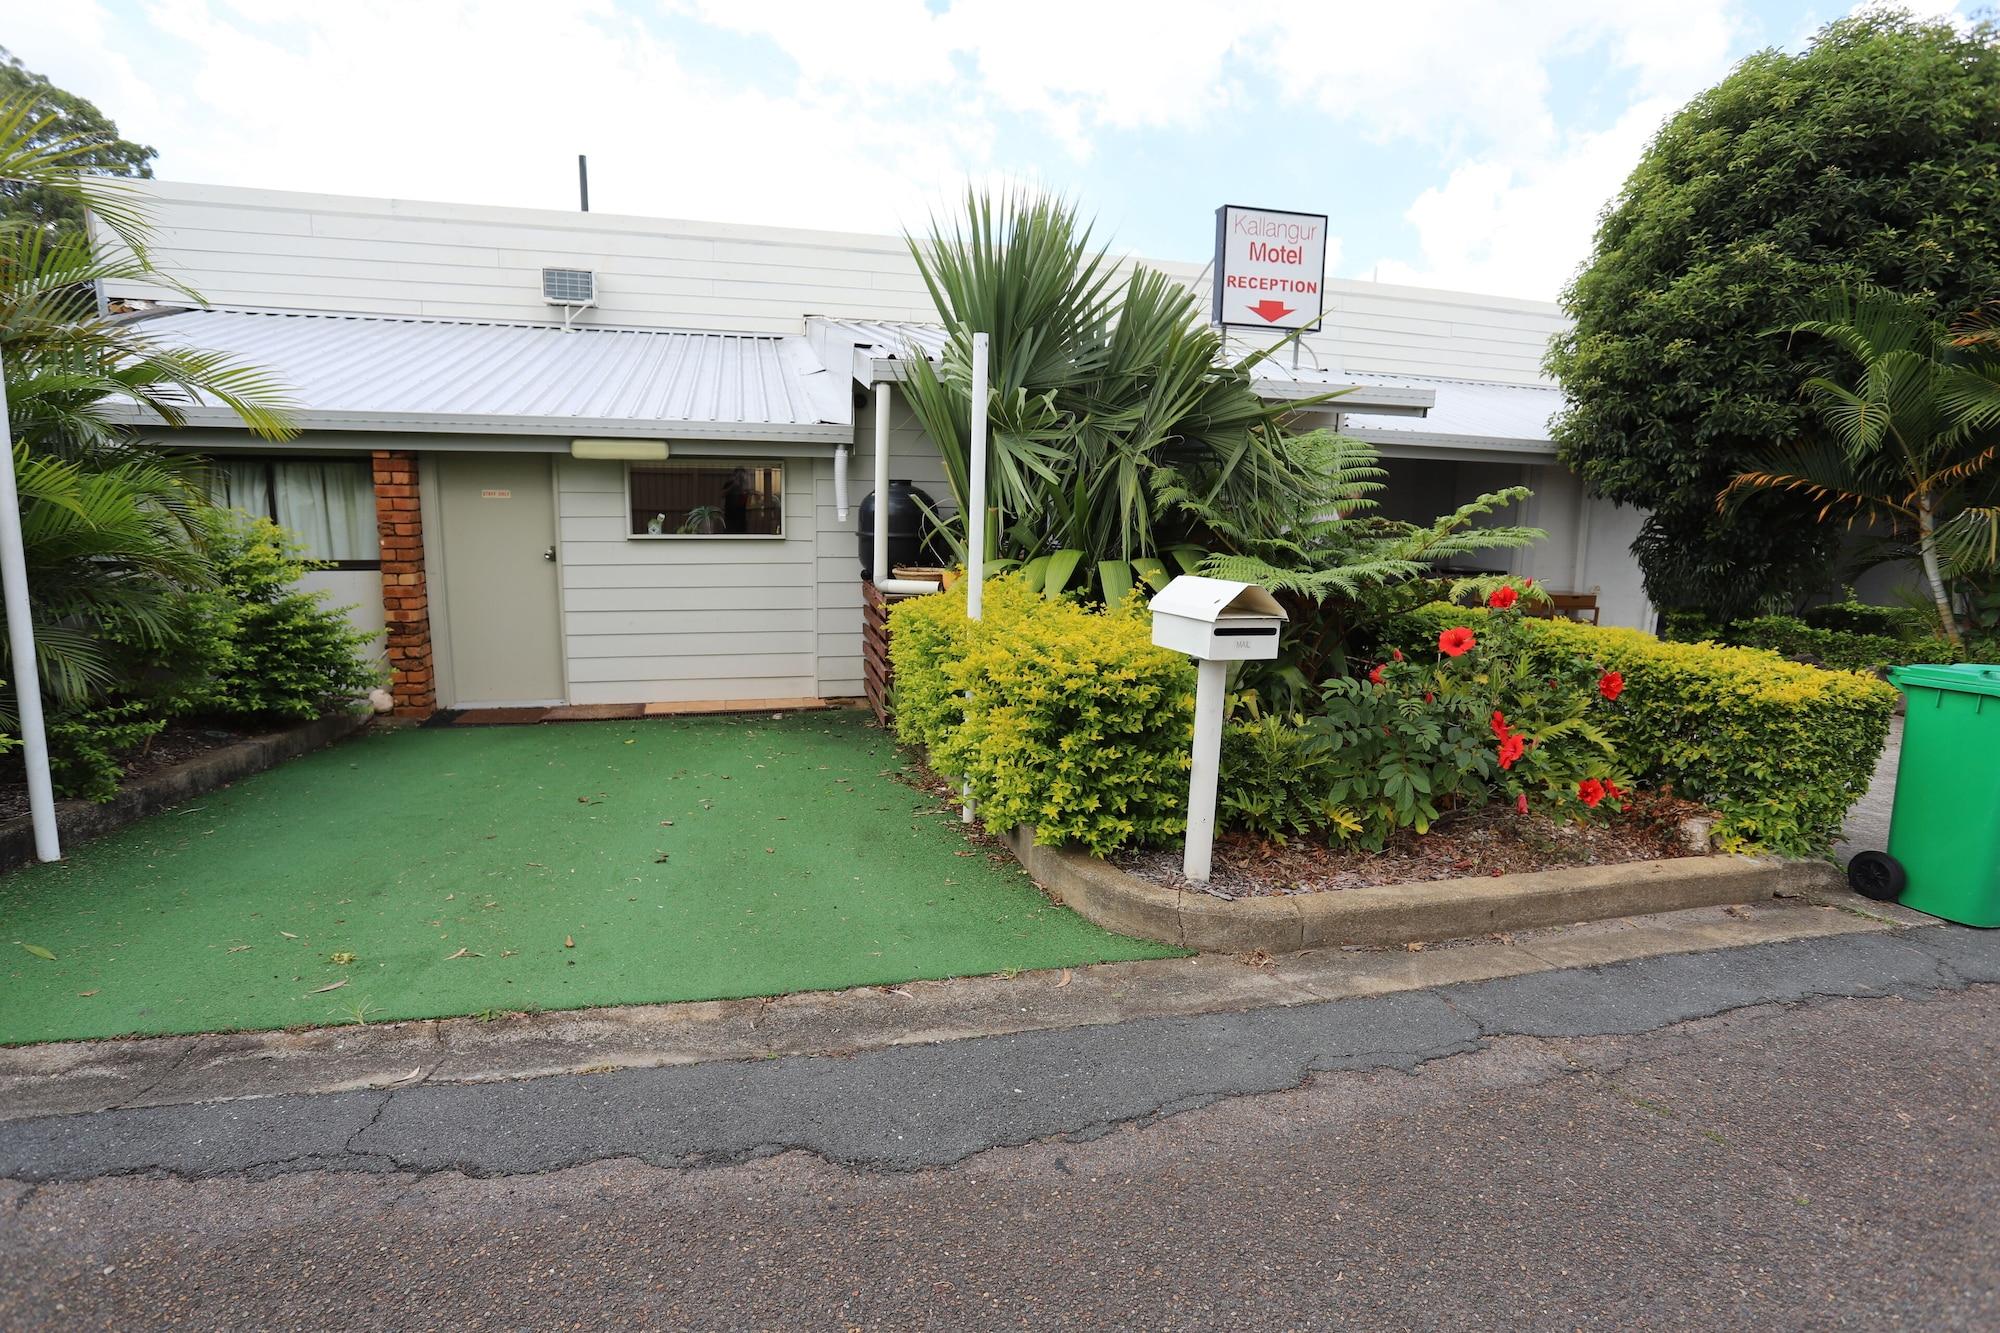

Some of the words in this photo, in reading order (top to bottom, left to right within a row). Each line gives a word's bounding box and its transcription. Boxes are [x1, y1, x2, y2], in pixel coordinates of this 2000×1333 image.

[1234, 214, 1317, 245] Kallangur
[1249, 241, 1303, 265] Motel
[1227, 275, 1317, 294] RECEPTION
